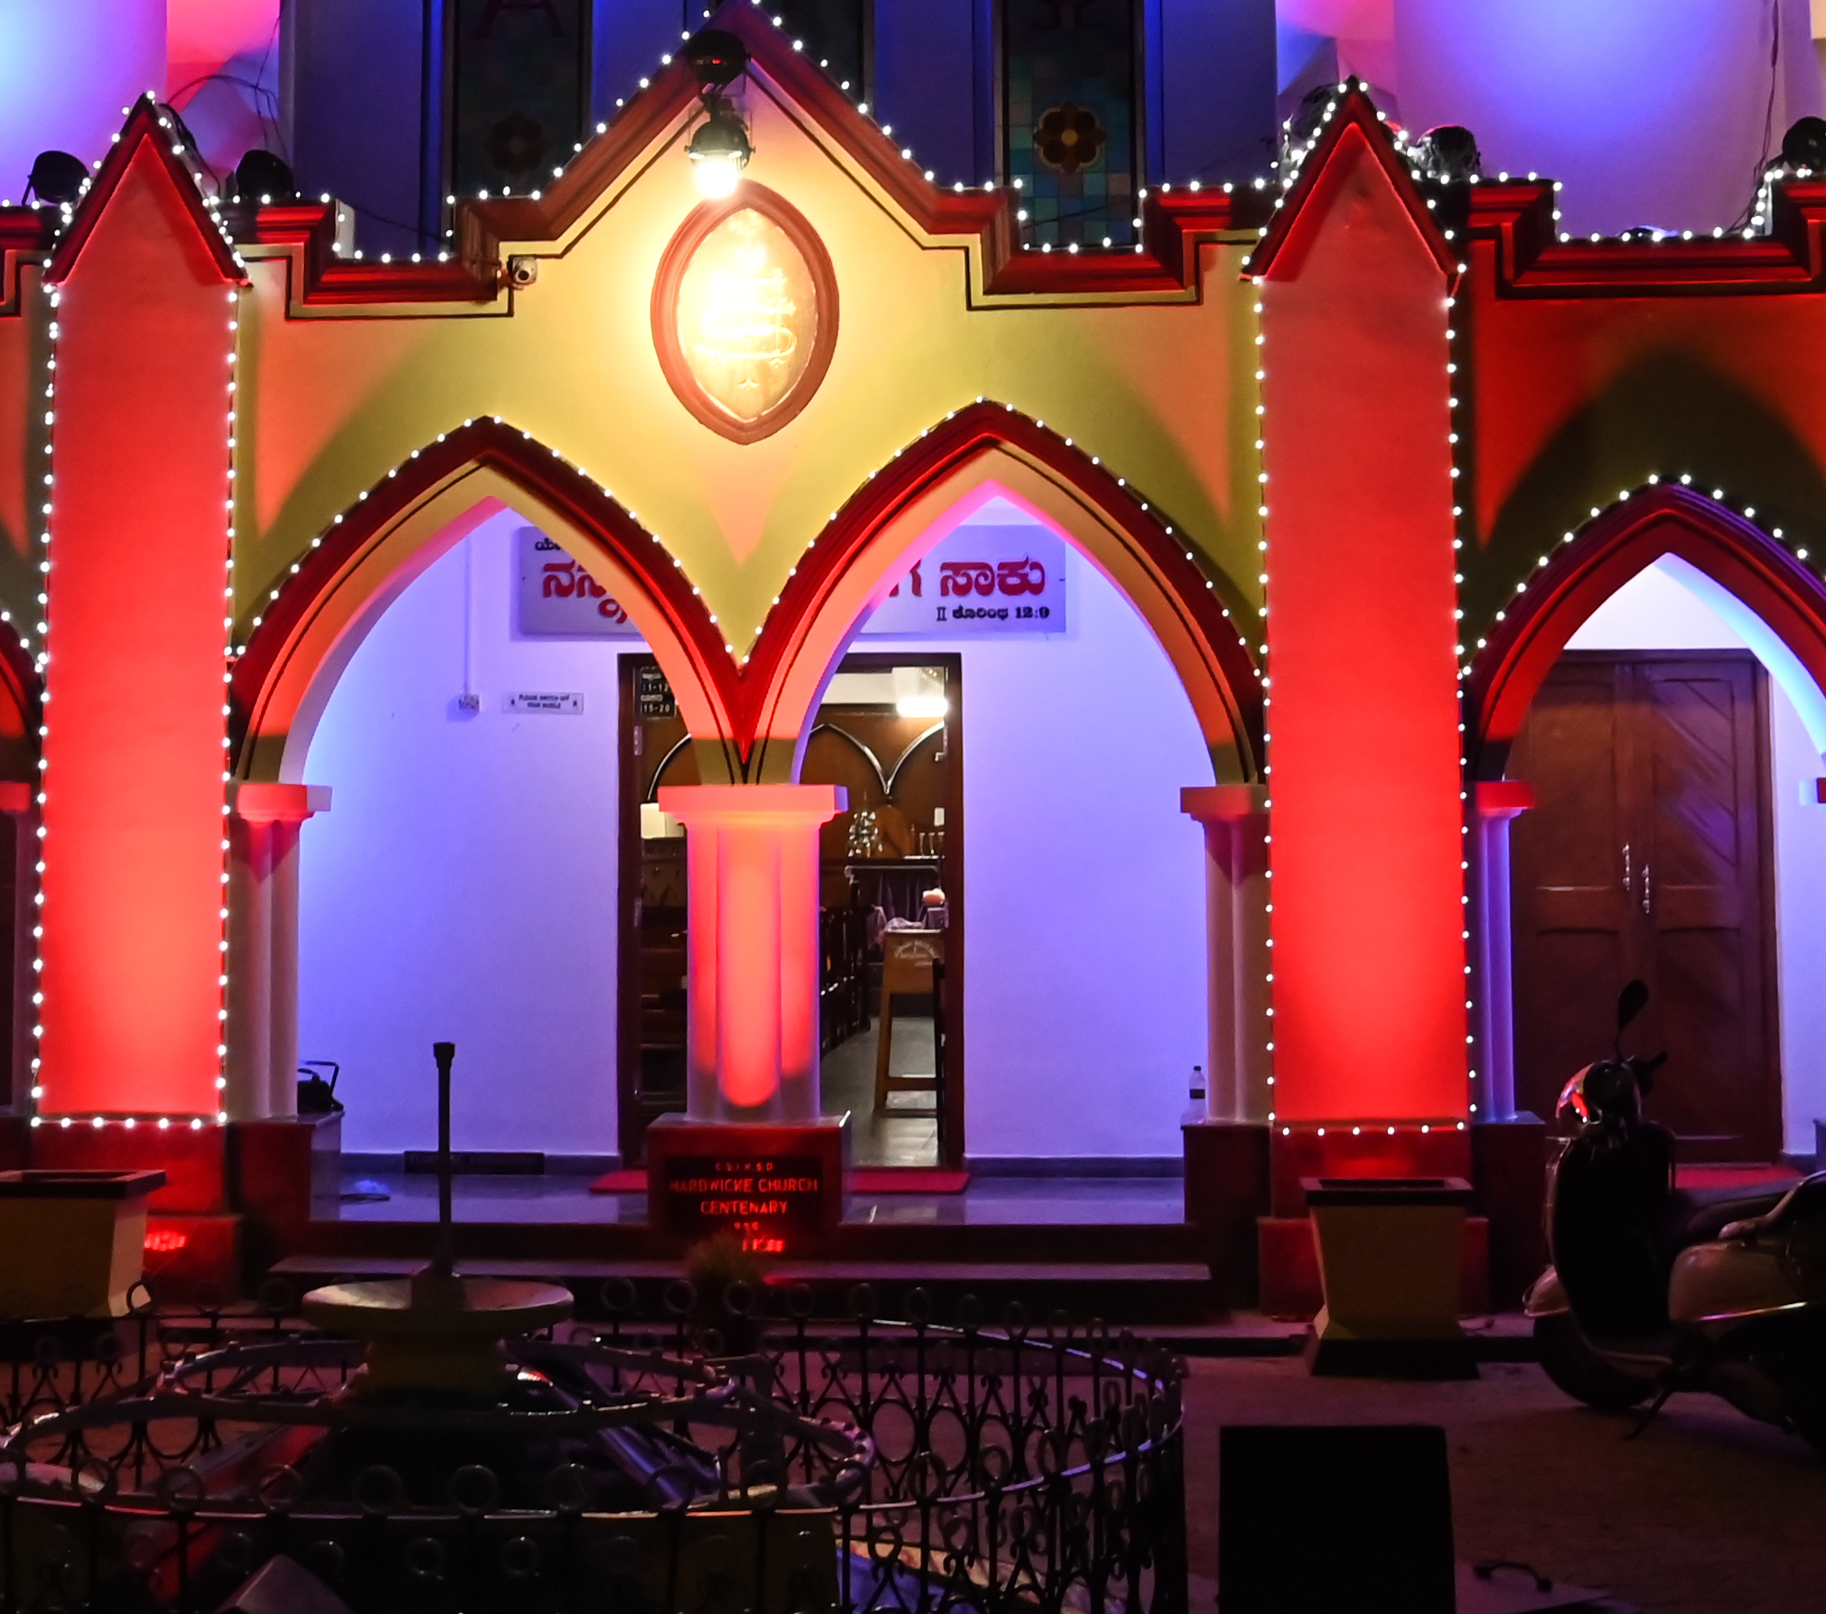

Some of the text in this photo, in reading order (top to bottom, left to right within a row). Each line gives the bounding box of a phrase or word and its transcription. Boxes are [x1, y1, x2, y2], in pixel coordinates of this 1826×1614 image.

[940, 556, 1046, 597] ಸಾಕು
[1015, 606, 1050, 619] 12:9
[669, 1177, 819, 1192] HARDWICKE CHURCH
[700, 1199, 789, 1215] CENTENARY
